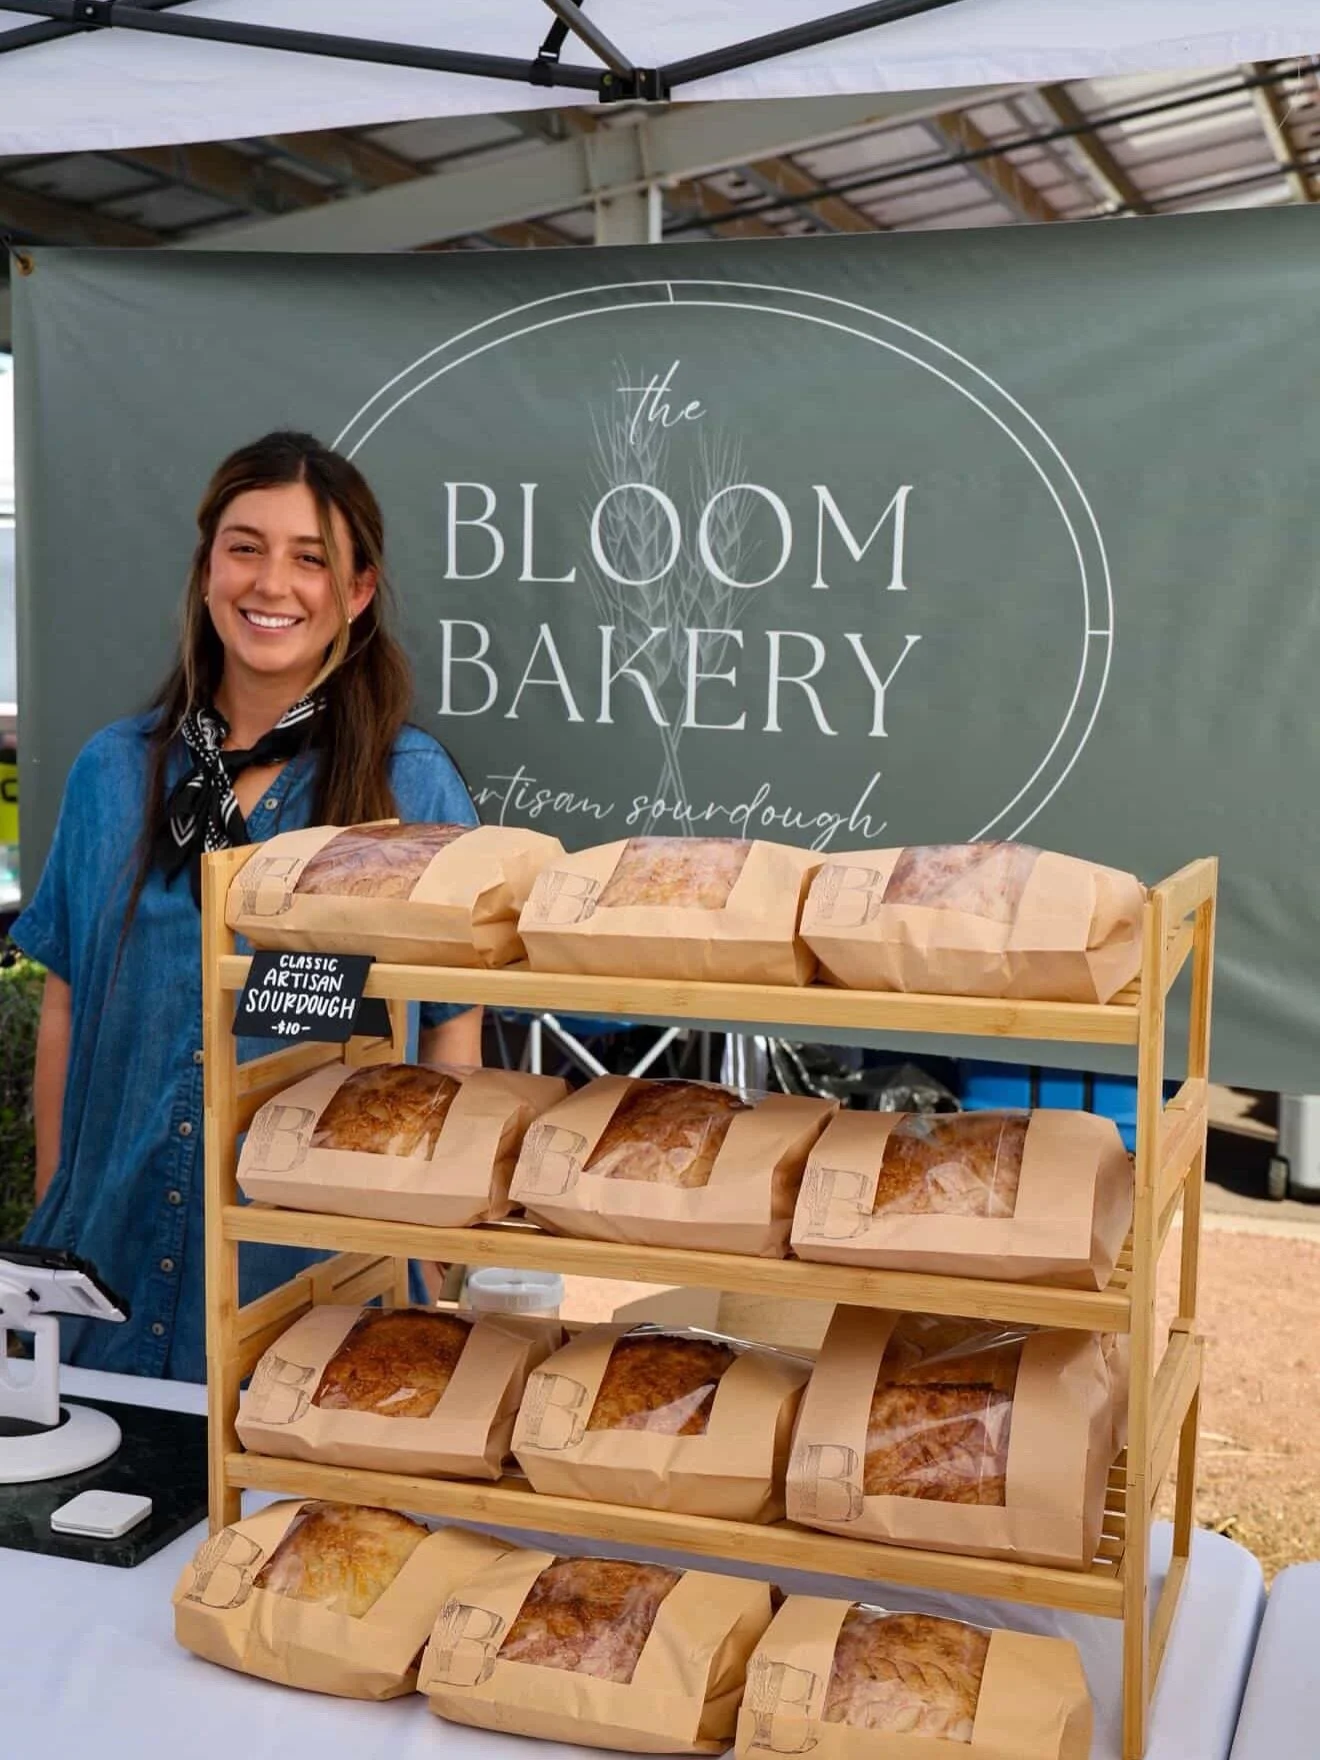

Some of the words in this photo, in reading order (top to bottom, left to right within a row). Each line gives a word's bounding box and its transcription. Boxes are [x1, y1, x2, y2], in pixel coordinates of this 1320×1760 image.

[617, 360, 706, 445] the
[443, 481, 914, 592] BLOOM
[437, 619, 922, 738] BAKERY
[473, 765, 615, 827] rtisan
[625, 772, 888, 850] sourdough
[245, 988, 356, 1020] SOURDOUGH
[263, 967, 345, 993] ARTISAN
[279, 954, 338, 972] CLASSIC
